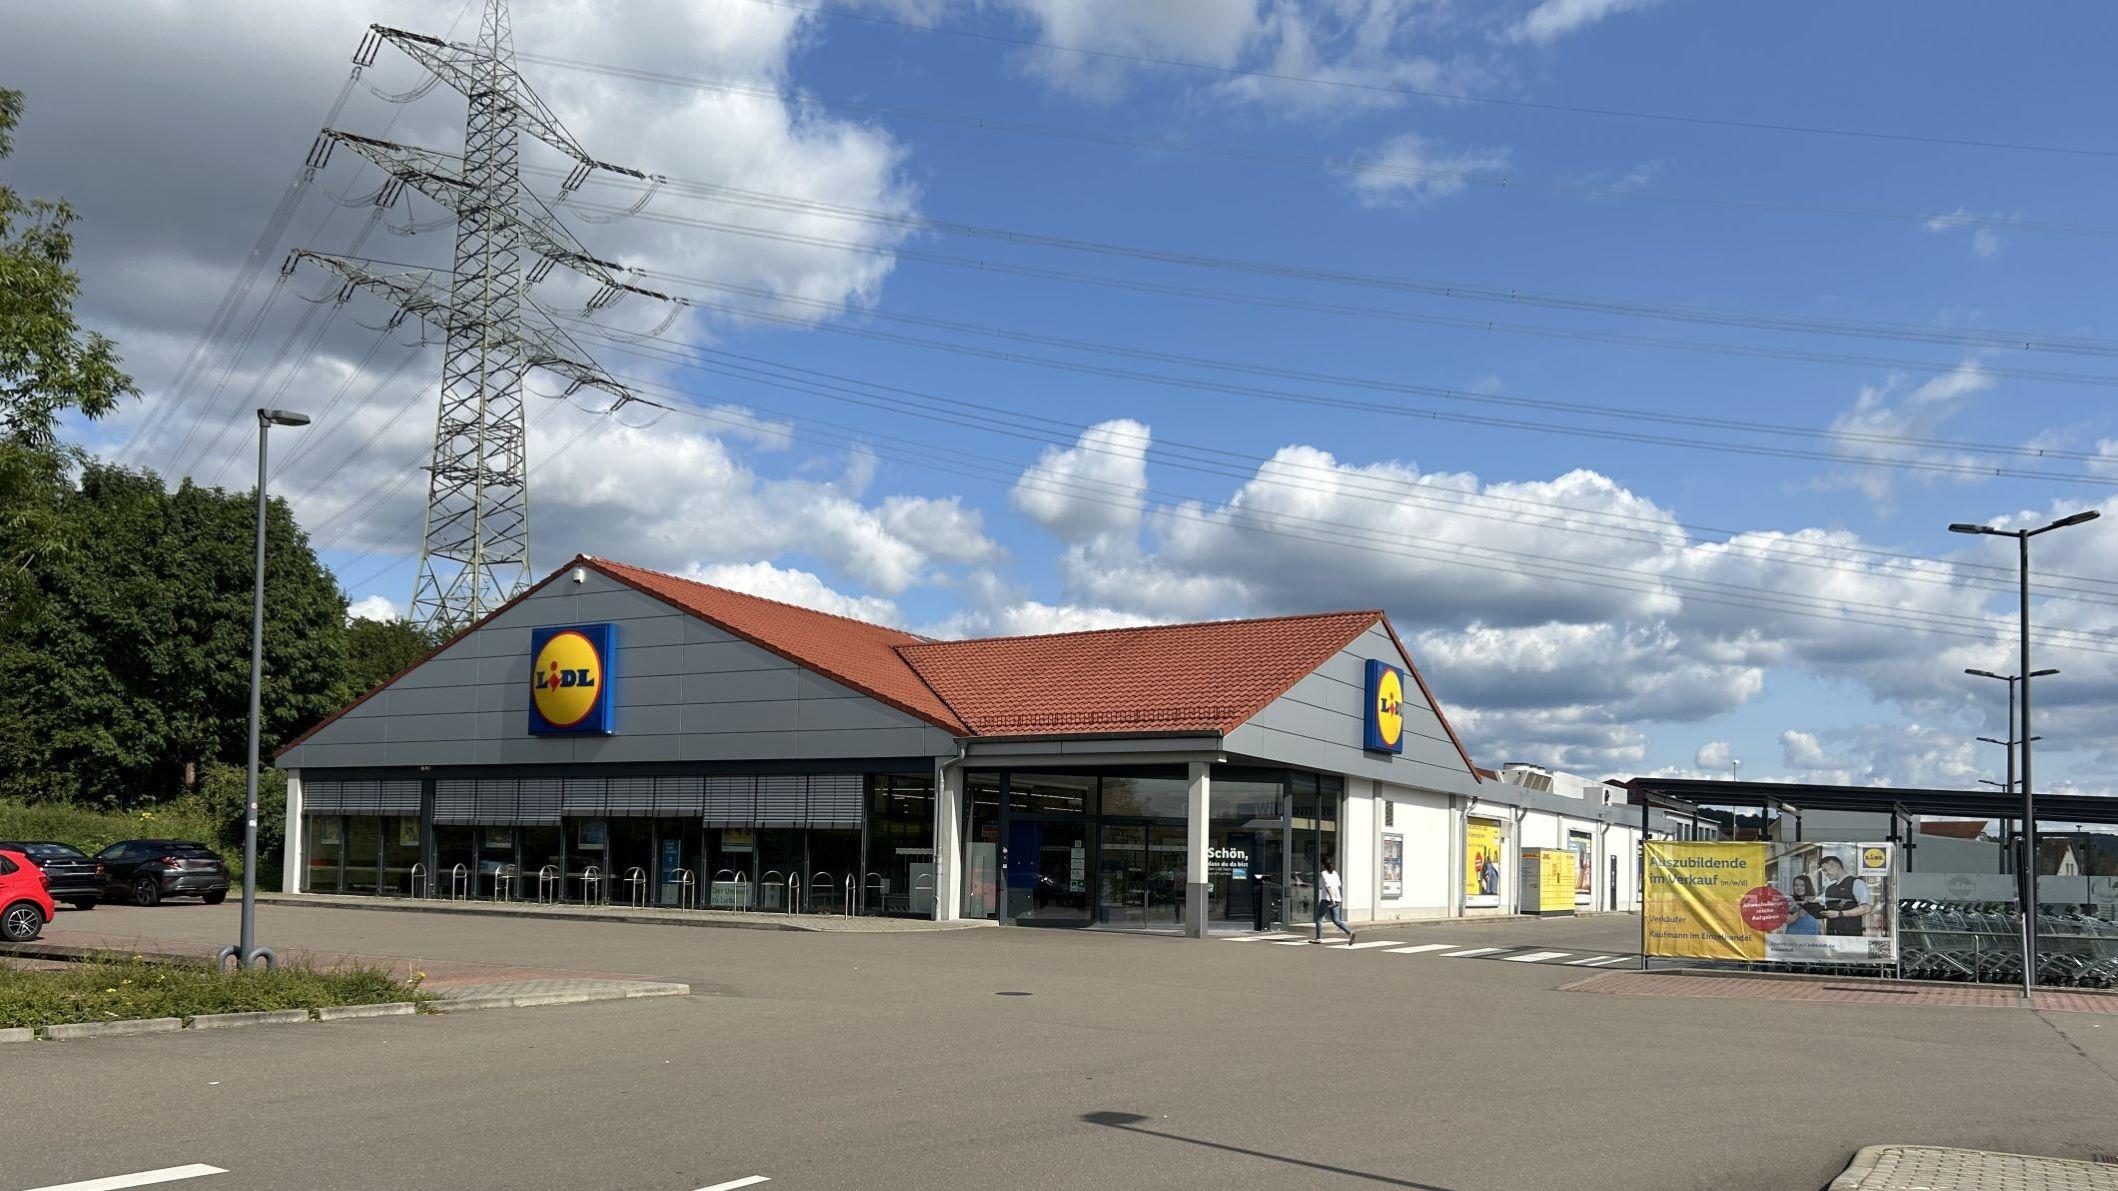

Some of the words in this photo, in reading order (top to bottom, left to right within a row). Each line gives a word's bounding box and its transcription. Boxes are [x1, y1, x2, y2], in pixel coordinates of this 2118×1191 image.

[1208, 847, 1249, 861] Schön,
[1649, 857, 1748, 869] Auszubildende
[1649, 873, 1665, 884] im
[1668, 874, 1719, 887] Verkauf
[1720, 879, 1749, 888] (m/w/d)
[1649, 930, 1688, 940] Kaufmann
